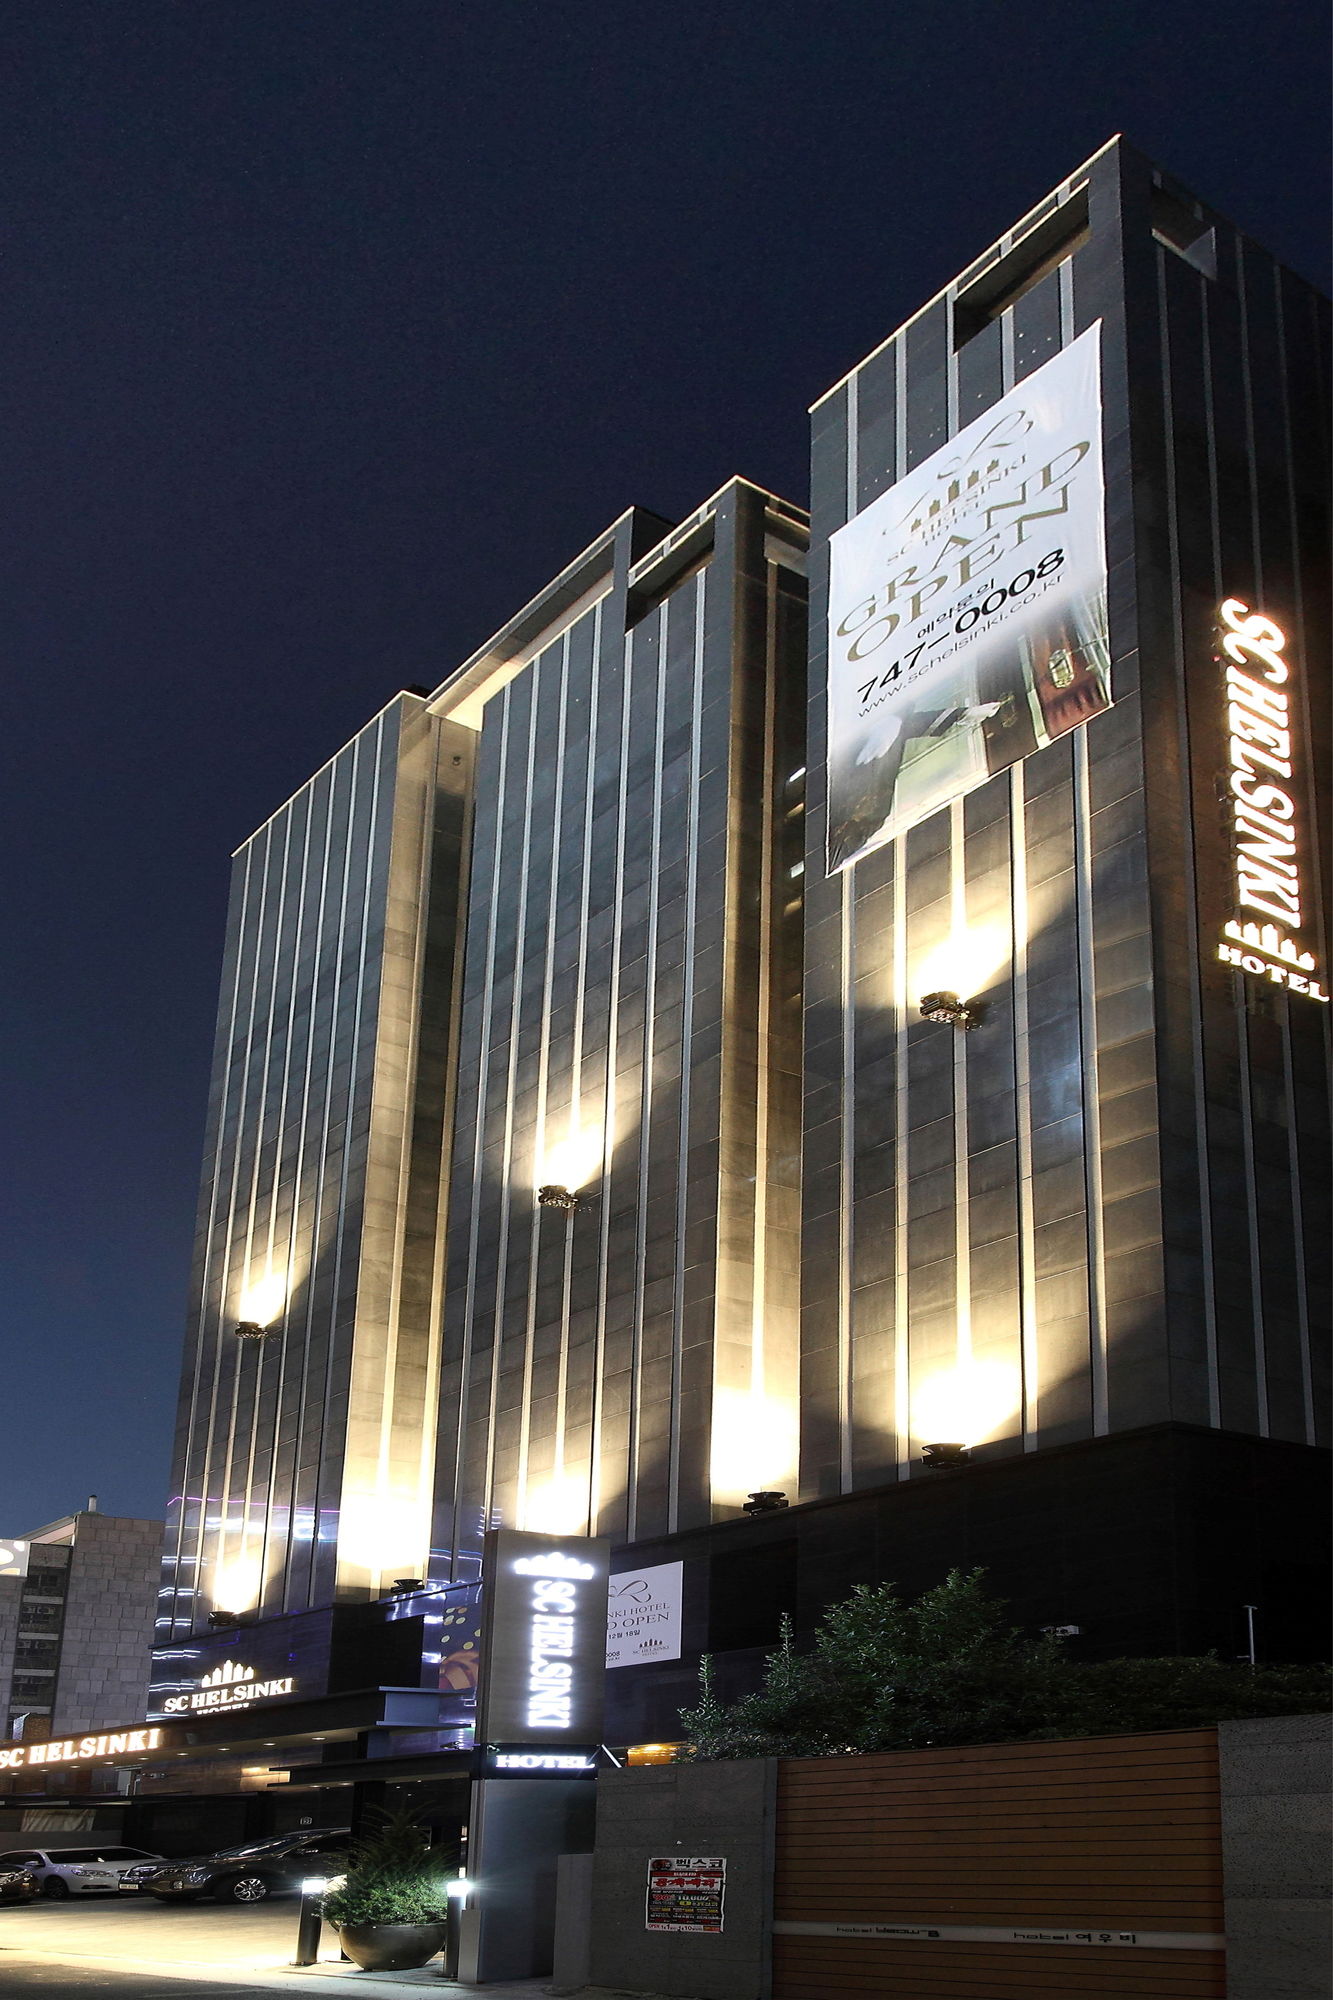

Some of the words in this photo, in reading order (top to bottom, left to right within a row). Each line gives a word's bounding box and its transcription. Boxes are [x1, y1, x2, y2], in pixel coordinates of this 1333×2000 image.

[836, 440, 1092, 638] GRAND
[847, 475, 1078, 662] OPEN
[857, 548, 1065, 704] 747-0008
[858, 571, 1065, 718] www.schelsinki.co.kr
[1220, 596, 1289, 685] SC
[1226, 664, 1301, 930] HELSINKI
[1217, 943, 1330, 1003] HOTEL
[532, 1580, 577, 1613] SC
[622, 1612, 670, 1628] OPEN
[630, 1602, 671, 1615] HOTEL
[625, 1629, 641, 1637] 18일
[163, 1695, 189, 1713] SC
[191, 1677, 294, 1709] HELSINKI
[527, 1614, 575, 1729] HELSINKI
[0, 1748, 25, 1769] SC
[28, 1728, 161, 1764] HELSINKI
[496, 1754, 595, 1769] HOTEL
[1013, 1932, 1069, 1940] hotel
